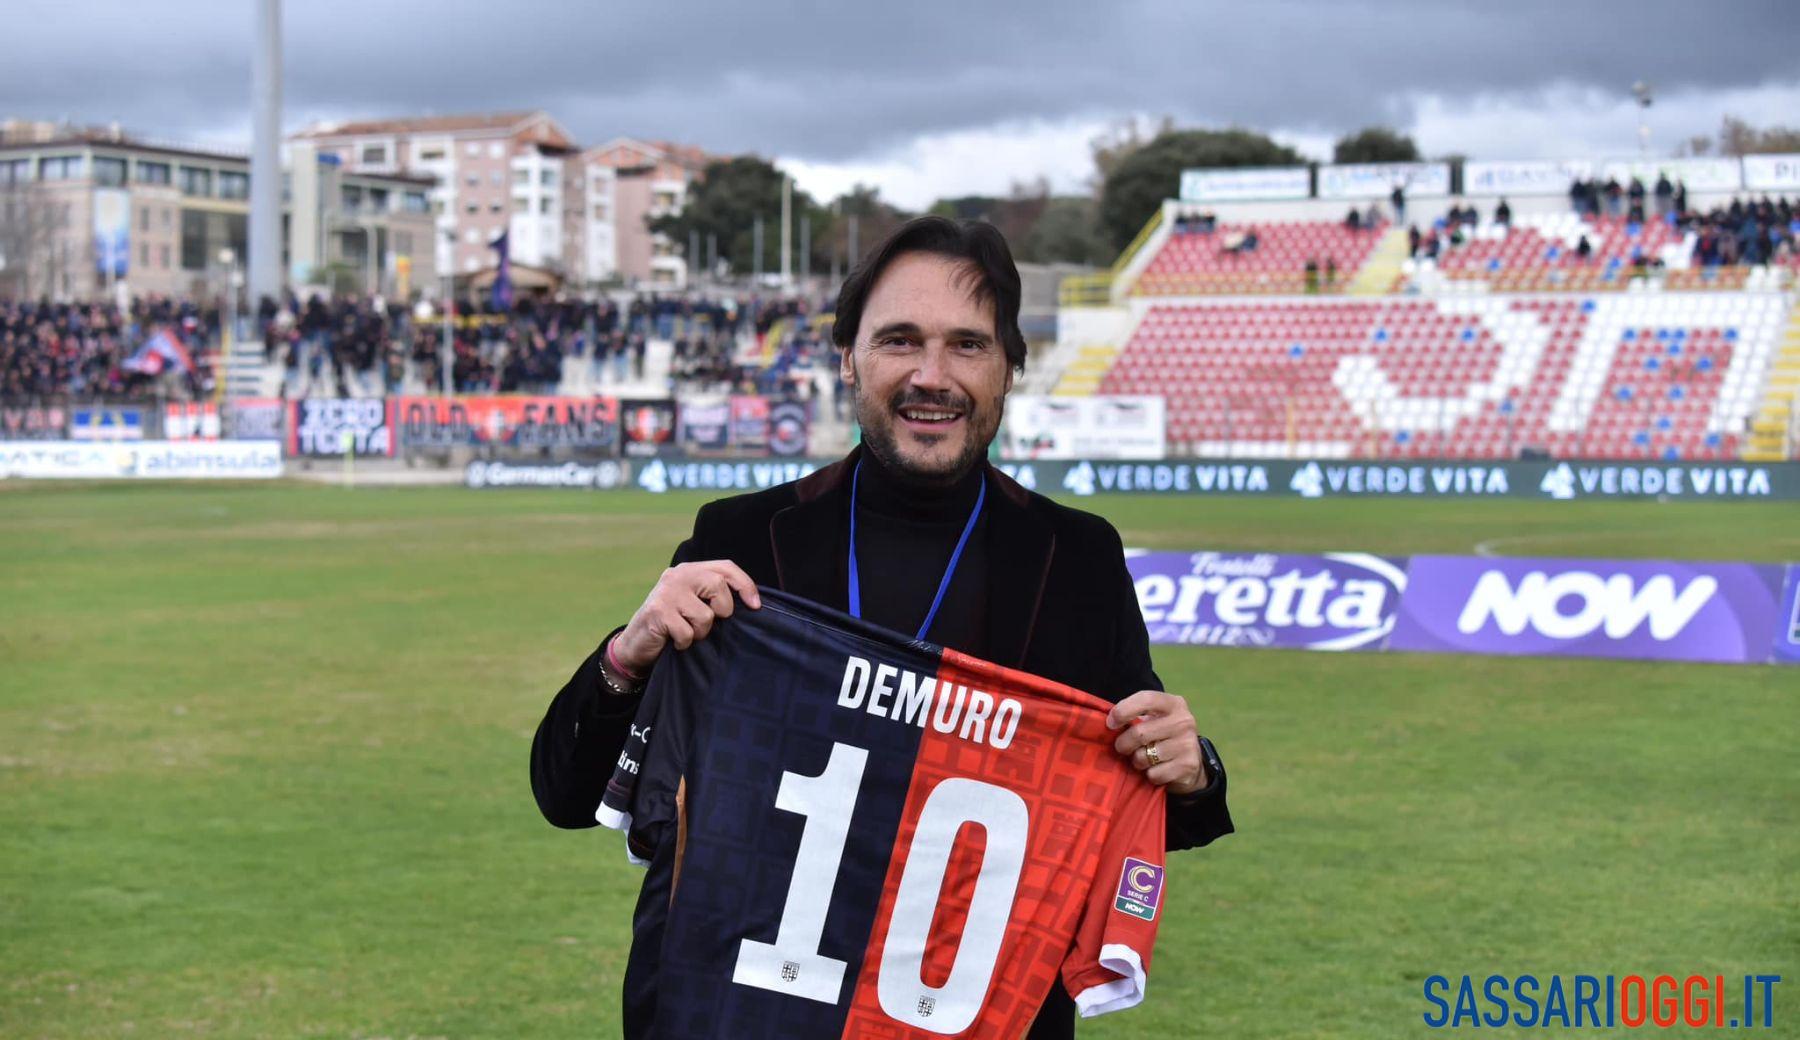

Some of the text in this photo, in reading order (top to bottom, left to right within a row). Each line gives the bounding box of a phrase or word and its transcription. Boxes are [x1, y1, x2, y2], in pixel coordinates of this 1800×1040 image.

[408, 402, 468, 442] OLD
[523, 402, 613, 443] FANS
[148, 449, 278, 471] abinsula
[667, 463, 750, 488] VERDE
[1098, 465, 1268, 491] VERDE VITA
[1326, 466, 1509, 494] VERDE VITA
[1578, 467, 1770, 495] VERDE VITA
[1457, 569, 1718, 641] NOW
[837, 655, 1023, 750] DEMURO
[732, 741, 1029, 1035] 10
[1127, 890, 1143, 901] SERIE
[1125, 902, 1145, 914] NOW
